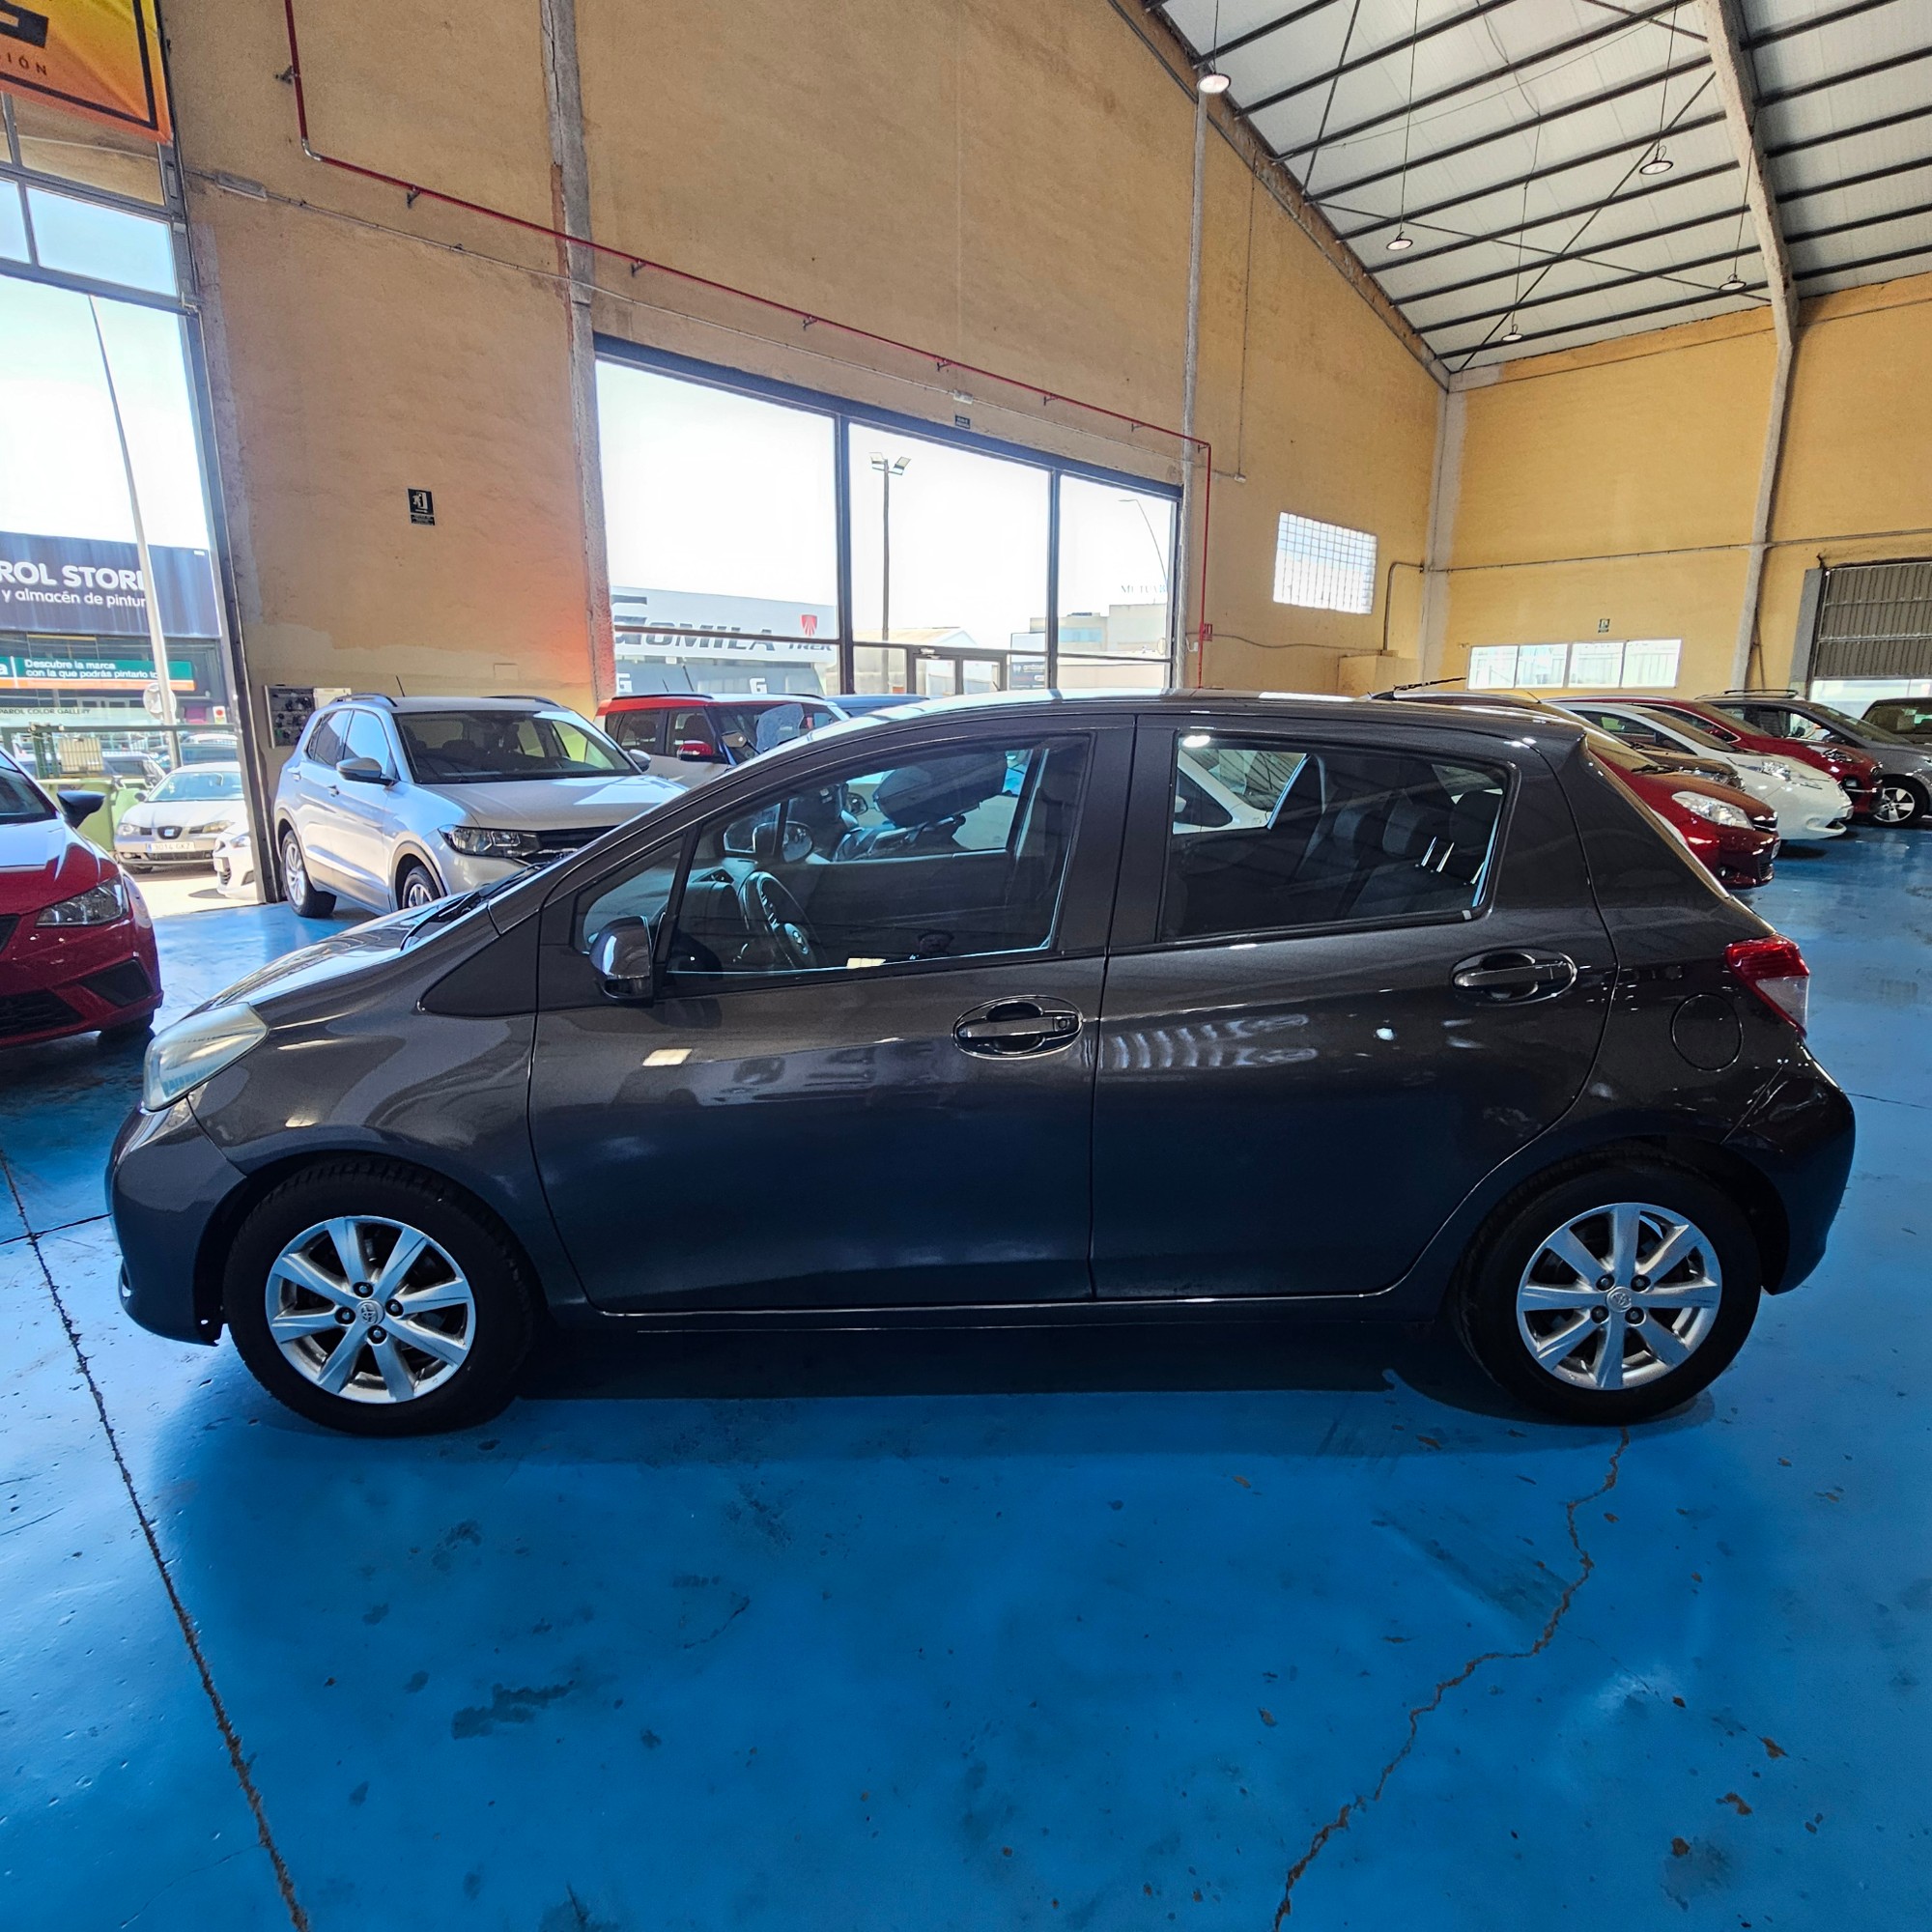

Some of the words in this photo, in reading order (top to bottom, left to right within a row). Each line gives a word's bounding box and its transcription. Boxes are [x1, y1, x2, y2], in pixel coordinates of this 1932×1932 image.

[0, 52, 47, 76] IÓN
[1, 589, 12, 604] y
[14, 587, 81, 605] almacén
[83, 591, 103, 606] de
[105, 593, 147, 609] pintur
[24, 659, 73, 669] Descubre
[74, 660, 85, 669] la
[86, 662, 116, 670] marca
[25, 668, 46, 678] con
[47, 668, 58, 678] la
[59, 670, 78, 680] que
[79, 669, 113, 679] podrás
[114, 670, 148, 679] pintarlo
